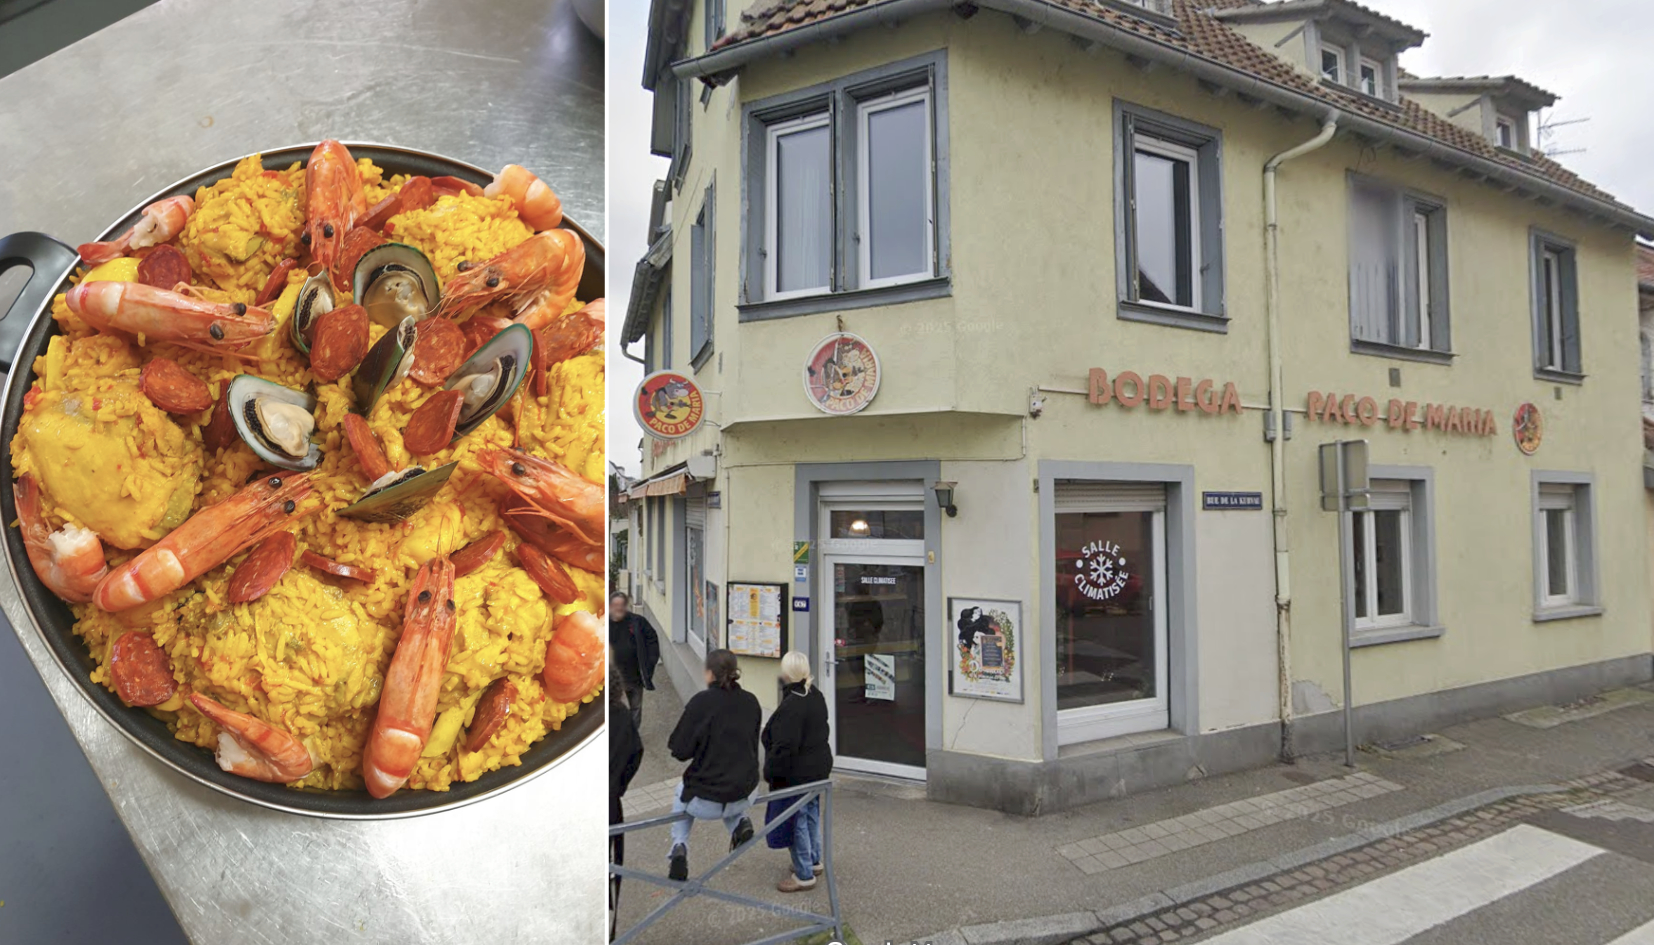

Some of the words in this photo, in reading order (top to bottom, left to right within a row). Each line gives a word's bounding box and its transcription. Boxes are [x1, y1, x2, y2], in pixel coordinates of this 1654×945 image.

[860, 347, 876, 387] MARIA
[825, 398, 855, 410] PACO
[855, 387, 868, 402] DE
[1088, 366, 1244, 415] BODEGA
[1307, 390, 1379, 427] PACO
[1388, 398, 1419, 430] DE
[1425, 402, 1499, 437] MARIA
[649, 417, 676, 433] PACO
[678, 423, 692, 432] DE
[688, 390, 701, 422] MARIA
[1081, 539, 1120, 558] SALLE
[1074, 570, 1129, 600] CLIMATISÉE
